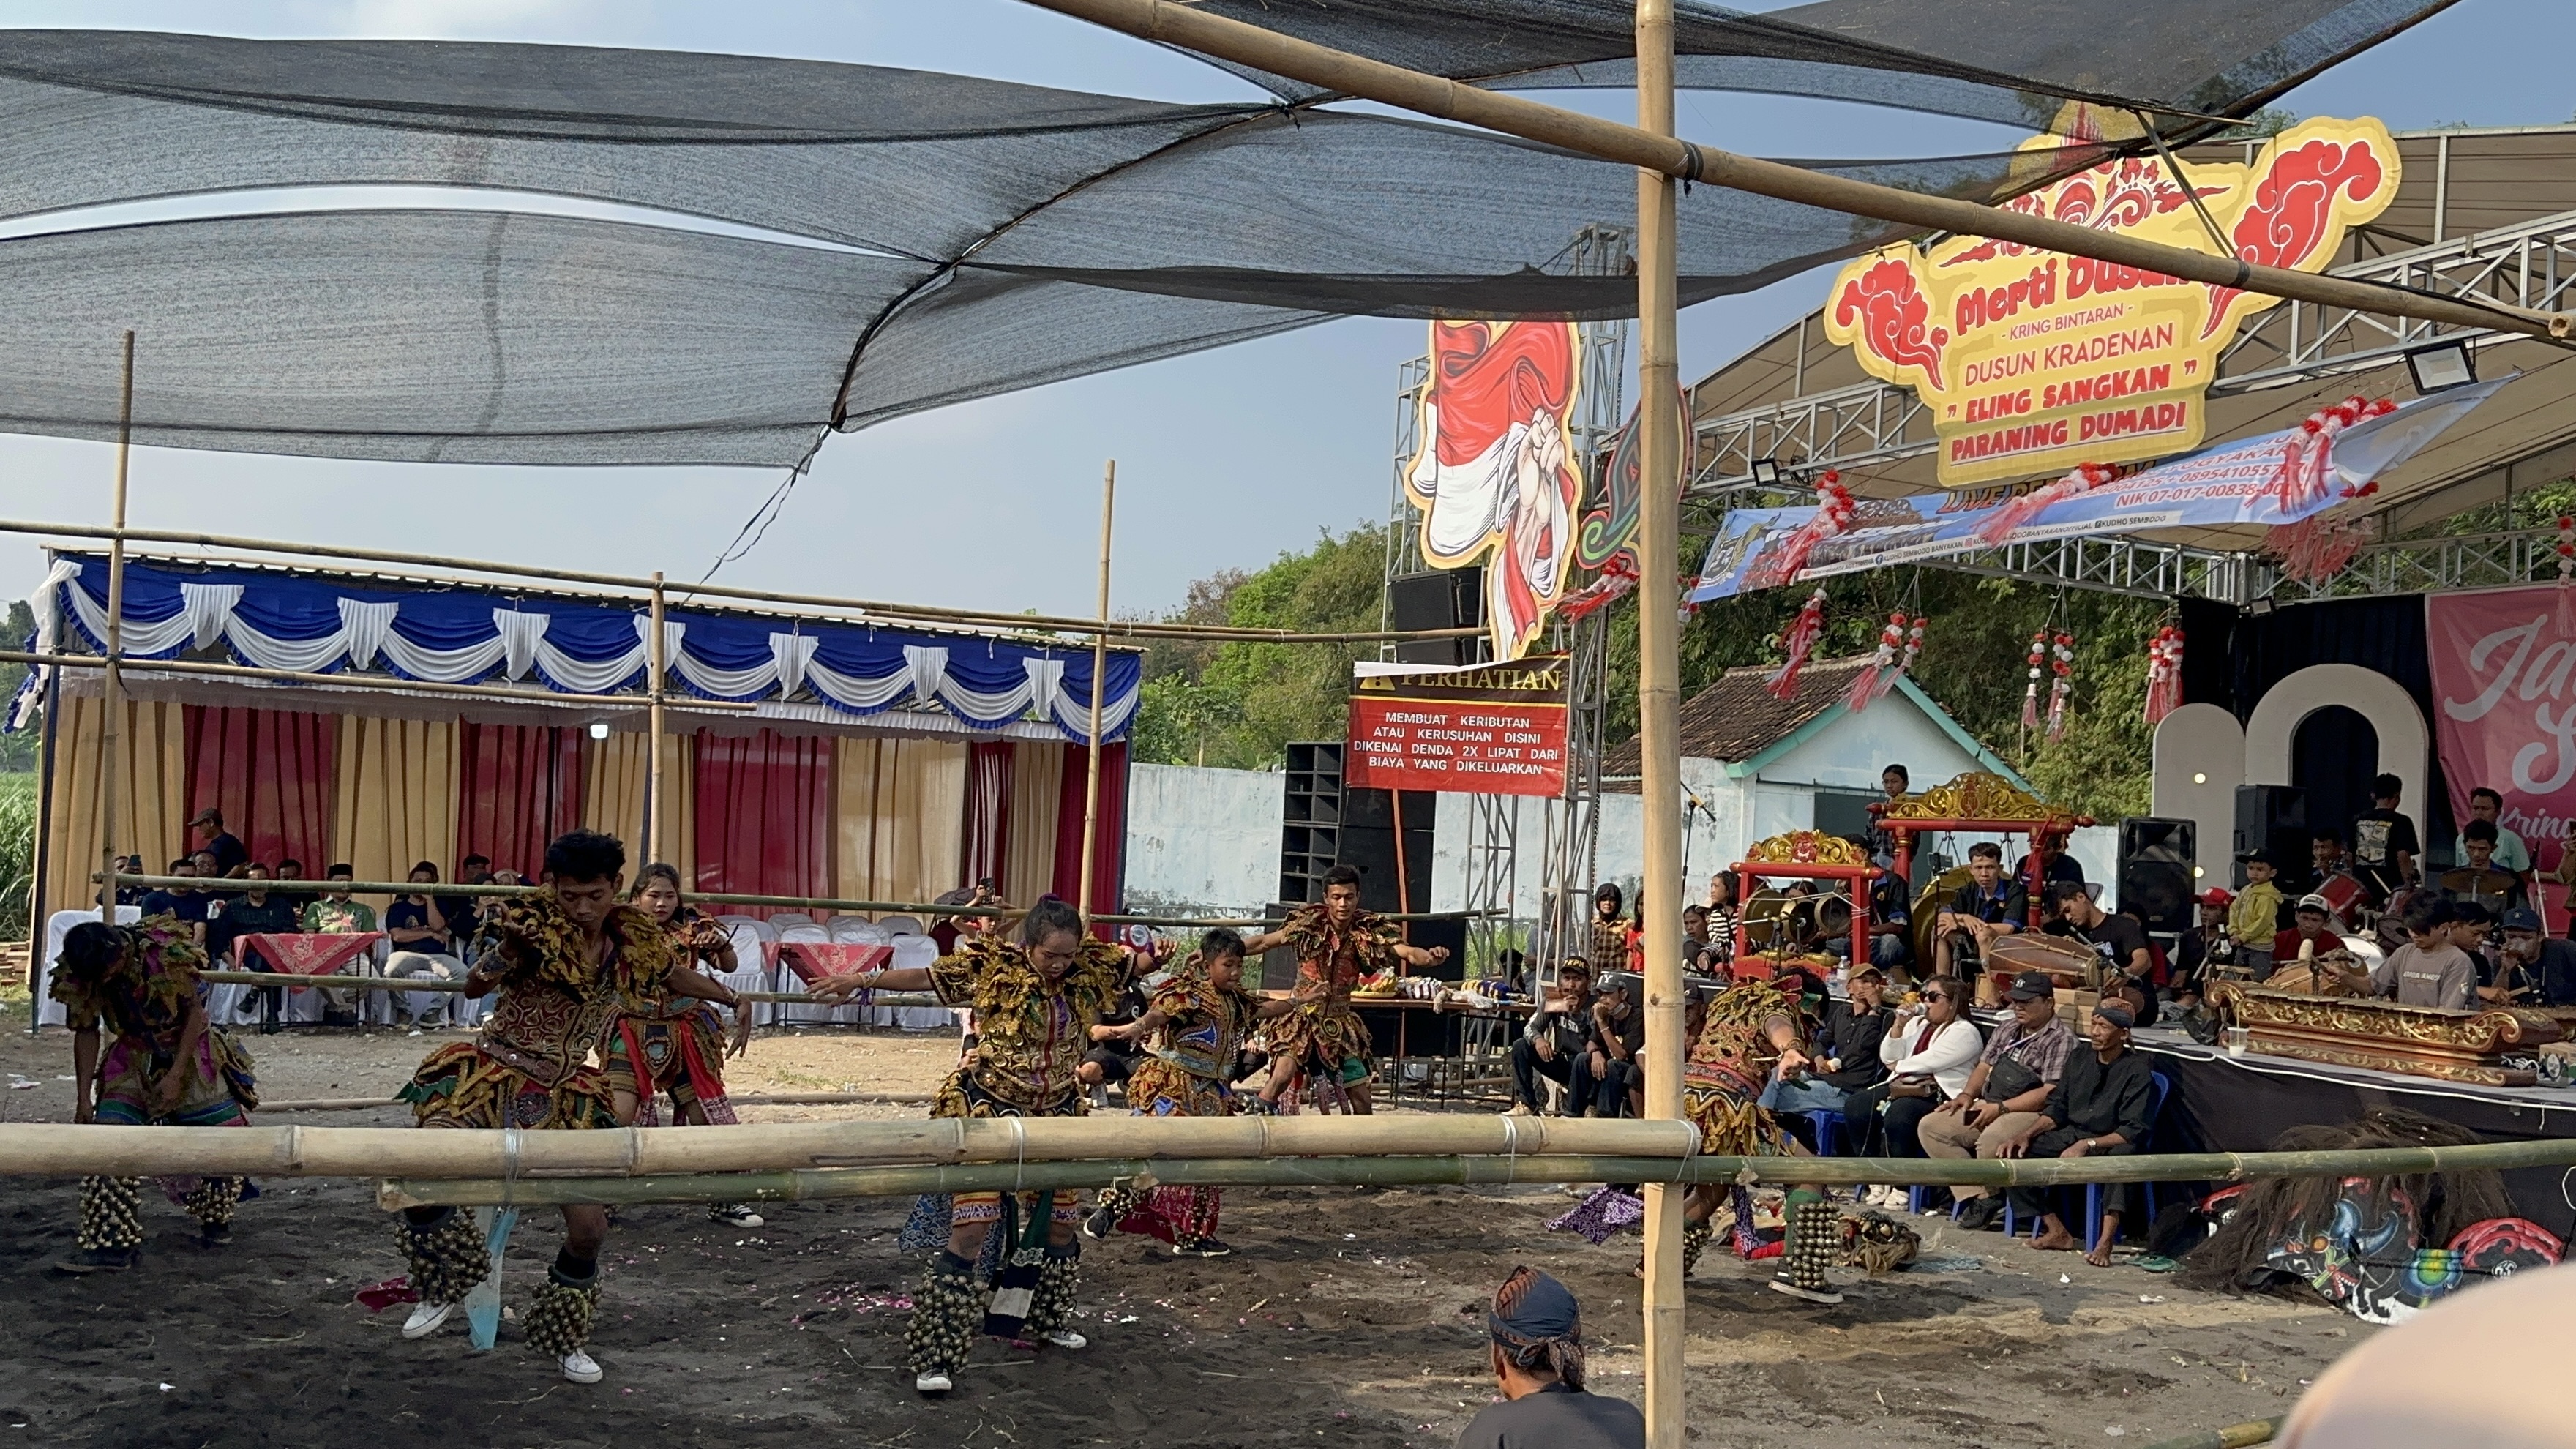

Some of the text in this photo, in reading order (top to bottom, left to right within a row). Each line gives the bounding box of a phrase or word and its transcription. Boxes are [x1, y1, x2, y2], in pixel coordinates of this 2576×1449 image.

[1956, 255, 2190, 336] Merti Dus
[2010, 318, 2051, 341] KRING
[2055, 303, 2124, 332] BINTARAN
[1965, 323, 2174, 386] DUSUN KRADENAN
[1966, 389, 2031, 424] ELING
[2043, 364, 2171, 408] SANGKAN
[1952, 401, 2187, 462] PARANING DUMADI
[2116, 492, 2146, 507] NIK
[1931, 541, 1963, 553] BANYAKAN
[2444, 613, 2576, 722] Ja
[1401, 669, 1562, 692] PERHATIAN
[1385, 711, 1530, 728] MEMBUAT KERIBUTAN
[1373, 727, 1540, 744] ATAU KERUSUHAN DISINI
[1354, 740, 1558, 760] DIKENAI DENDA 2X LIPAT DARI
[1369, 756, 1542, 775] BIAYA YANG DIKELUARKAN
